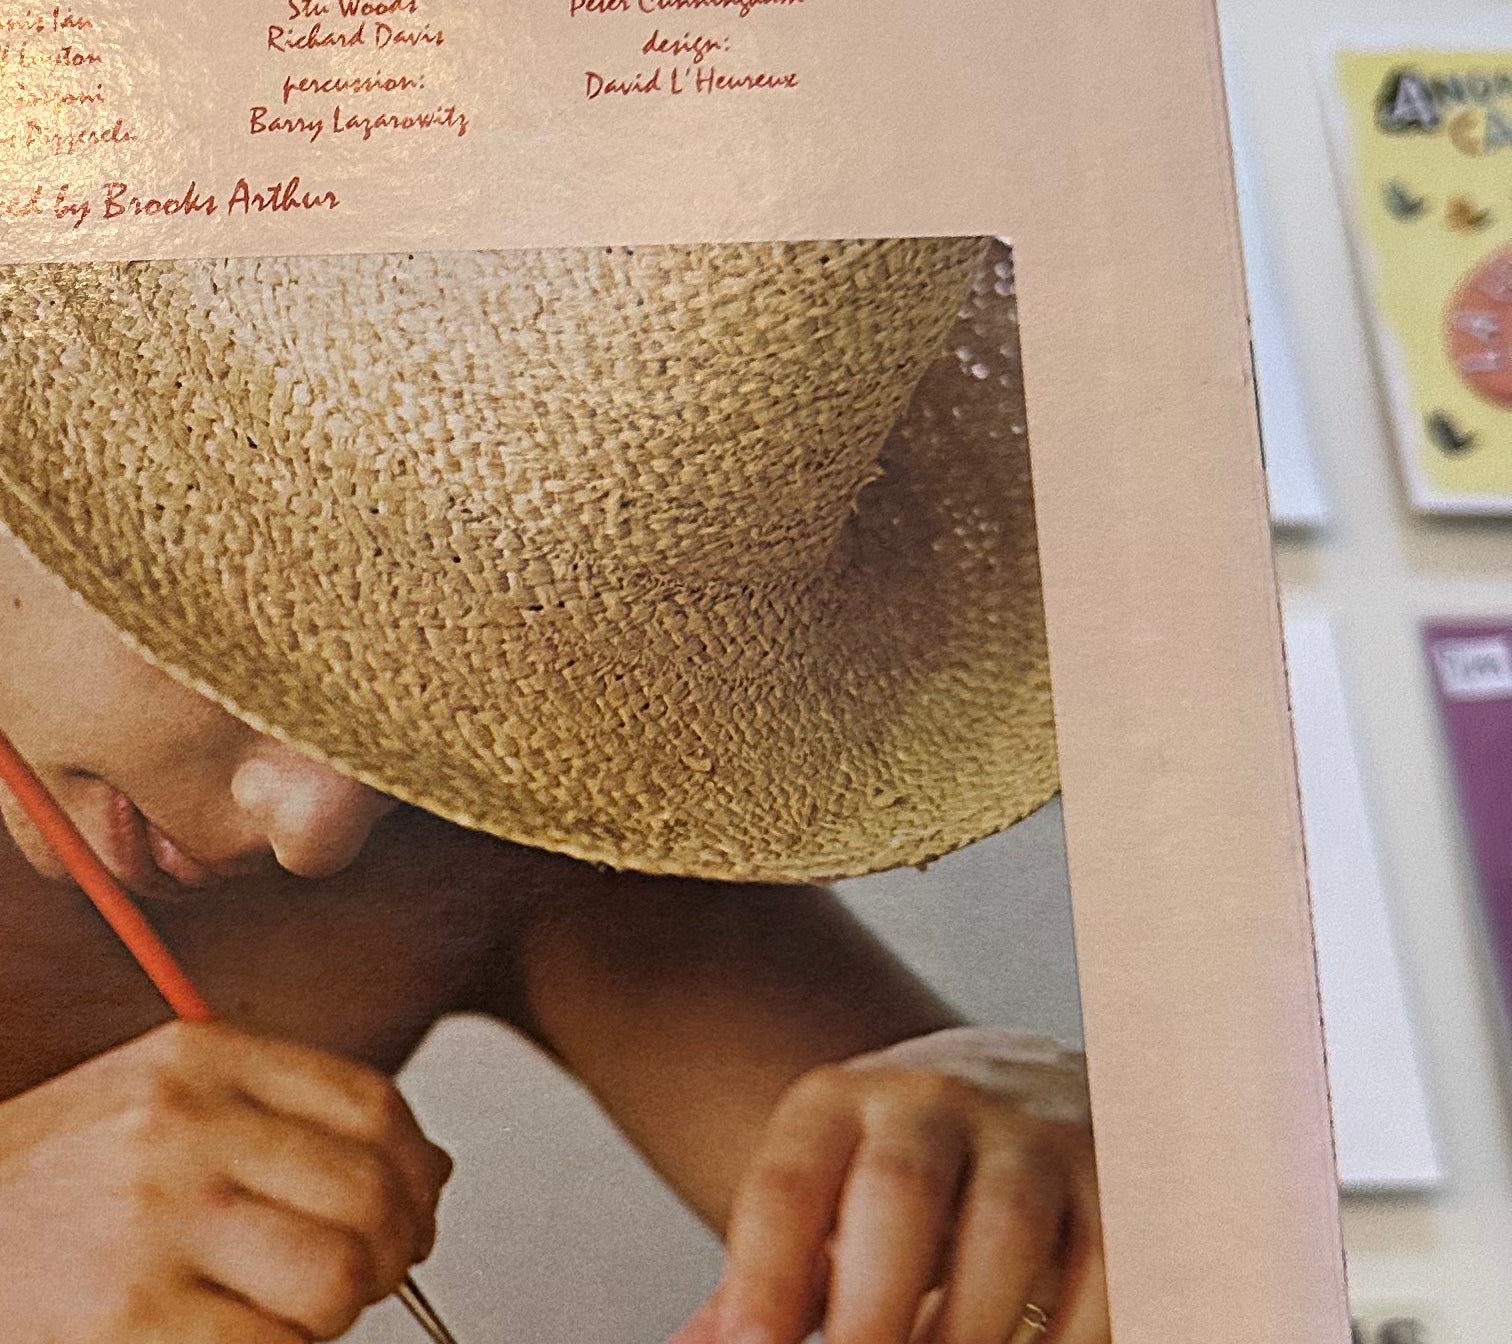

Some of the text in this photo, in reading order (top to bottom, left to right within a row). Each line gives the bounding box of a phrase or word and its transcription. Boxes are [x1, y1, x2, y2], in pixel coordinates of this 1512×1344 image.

[267, 22, 445, 51] Richard Davis
[642, 32, 731, 60] design:
[283, 72, 425, 103] percussion:
[586, 69, 661, 99] David
[251, 104, 470, 142] Barry Lazarowitz
[54, 185, 90, 230] by
[103, 181, 217, 219] Brooks
[228, 176, 340, 216] Arthur
